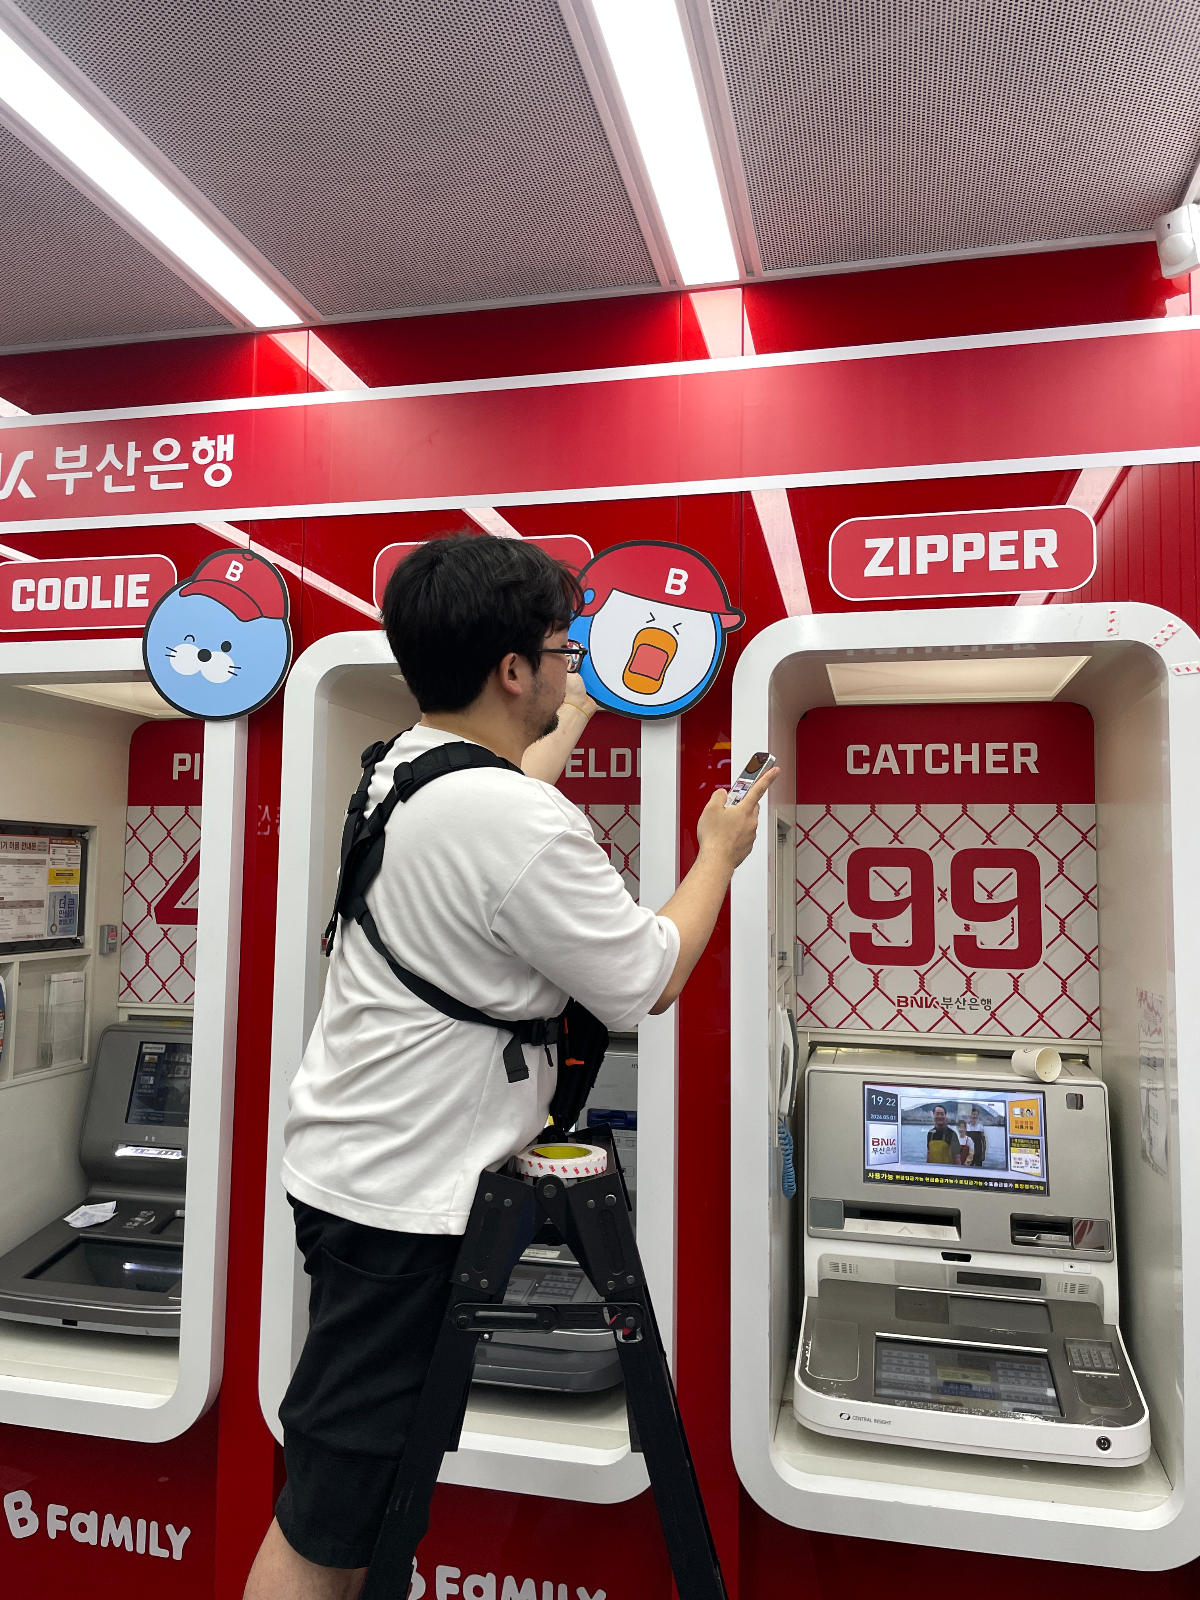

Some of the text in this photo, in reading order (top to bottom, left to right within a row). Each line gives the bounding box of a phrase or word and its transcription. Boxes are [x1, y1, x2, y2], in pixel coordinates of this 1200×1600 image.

[46, 433, 235, 496] 부산은행
[863, 528, 1059, 578] ZIPPER
[225, 560, 244, 582] B
[664, 567, 689, 596] B
[11, 573, 150, 611] COOLIE
[565, 747, 641, 778] ELD
[846, 742, 1040, 775] CATCHER
[846, 847, 1043, 970] 99
[896, 995, 992, 1012] BNK 부산은행
[871, 1137, 896, 1147] BNK
[852, 1415, 892, 1426] CENTRAL INSIGHT
[4, 1489, 39, 1539] B
